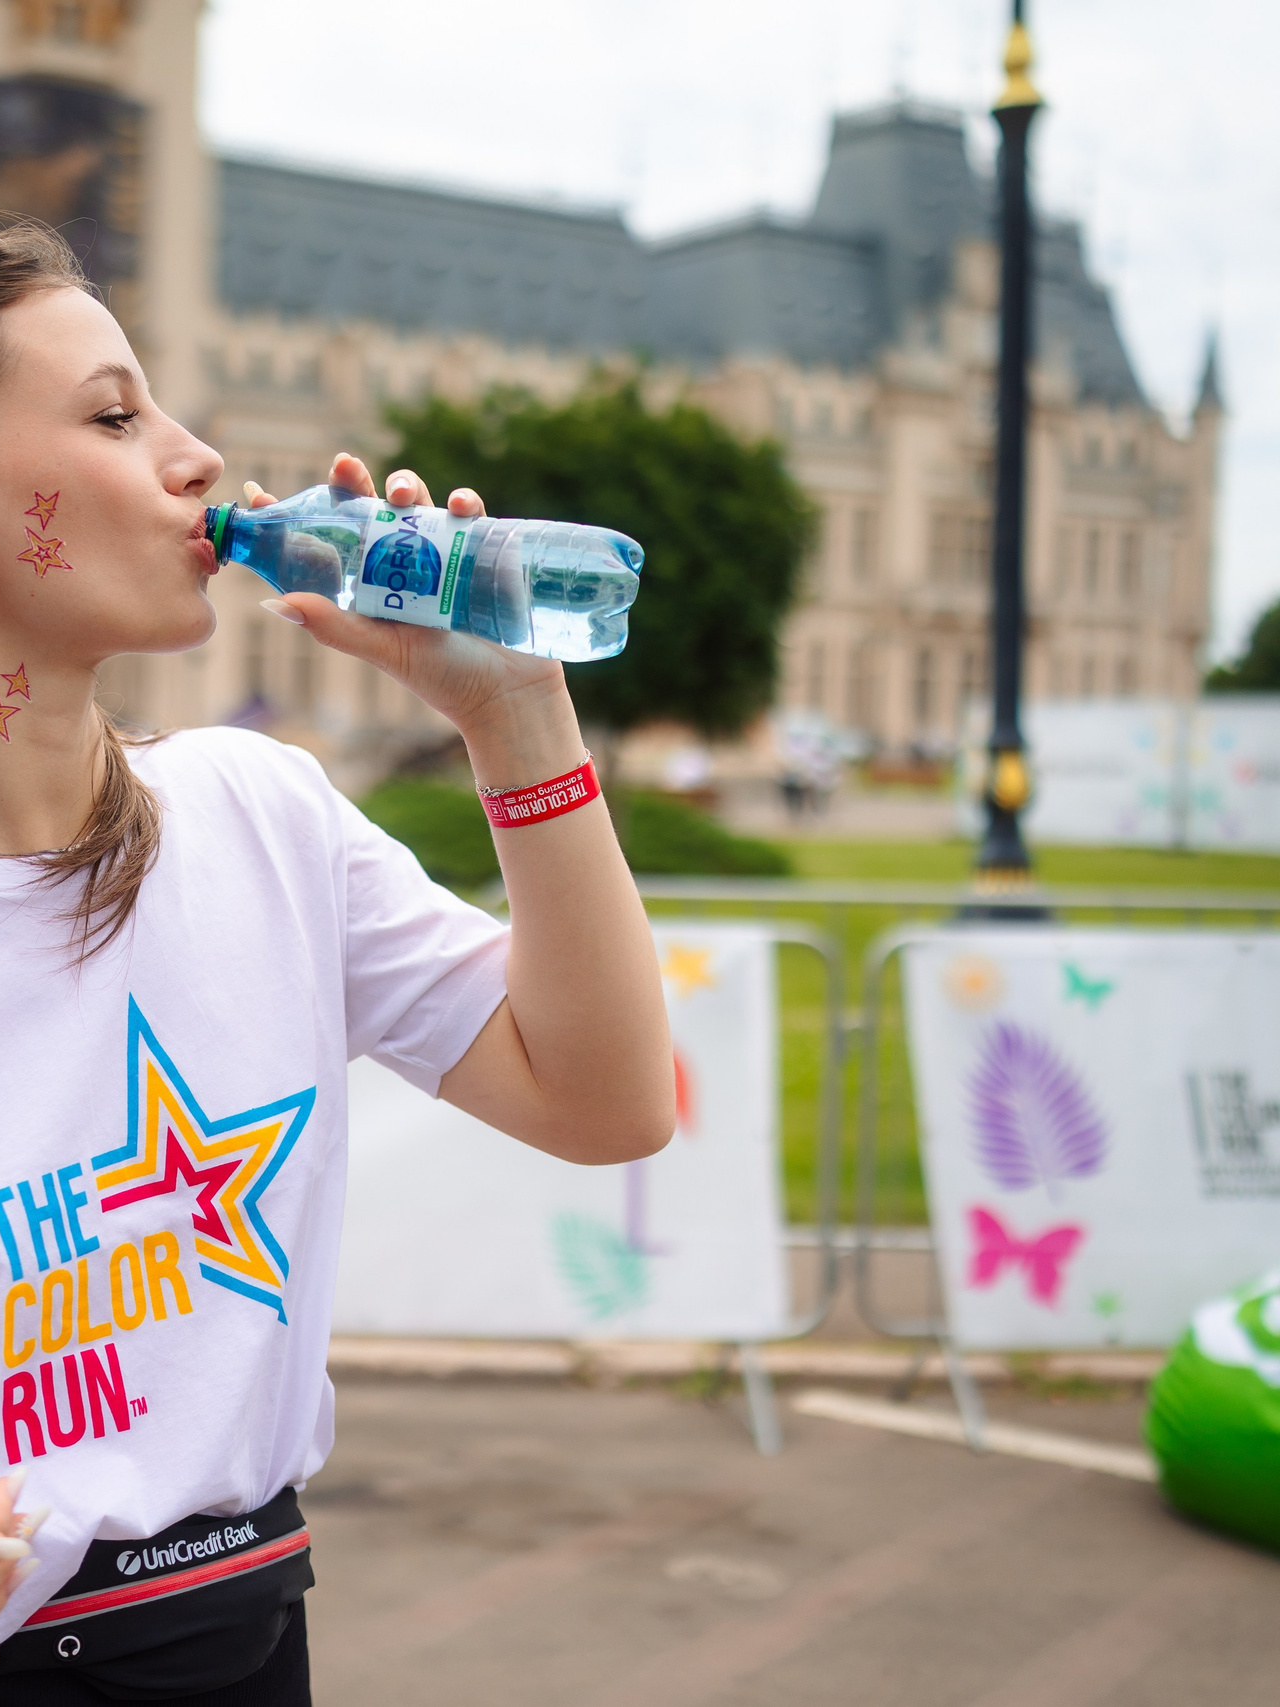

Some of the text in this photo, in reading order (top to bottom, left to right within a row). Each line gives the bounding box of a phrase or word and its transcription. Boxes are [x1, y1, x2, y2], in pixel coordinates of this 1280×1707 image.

[384, 515, 423, 610] DORNA
[518, 776, 577, 803] amazing tour
[531, 790, 569, 815] COLOR
[566, 781, 588, 803] THE
[3, 1230, 194, 1369] COLOR
[143, 1520, 260, 1570] UniCredit Bank
